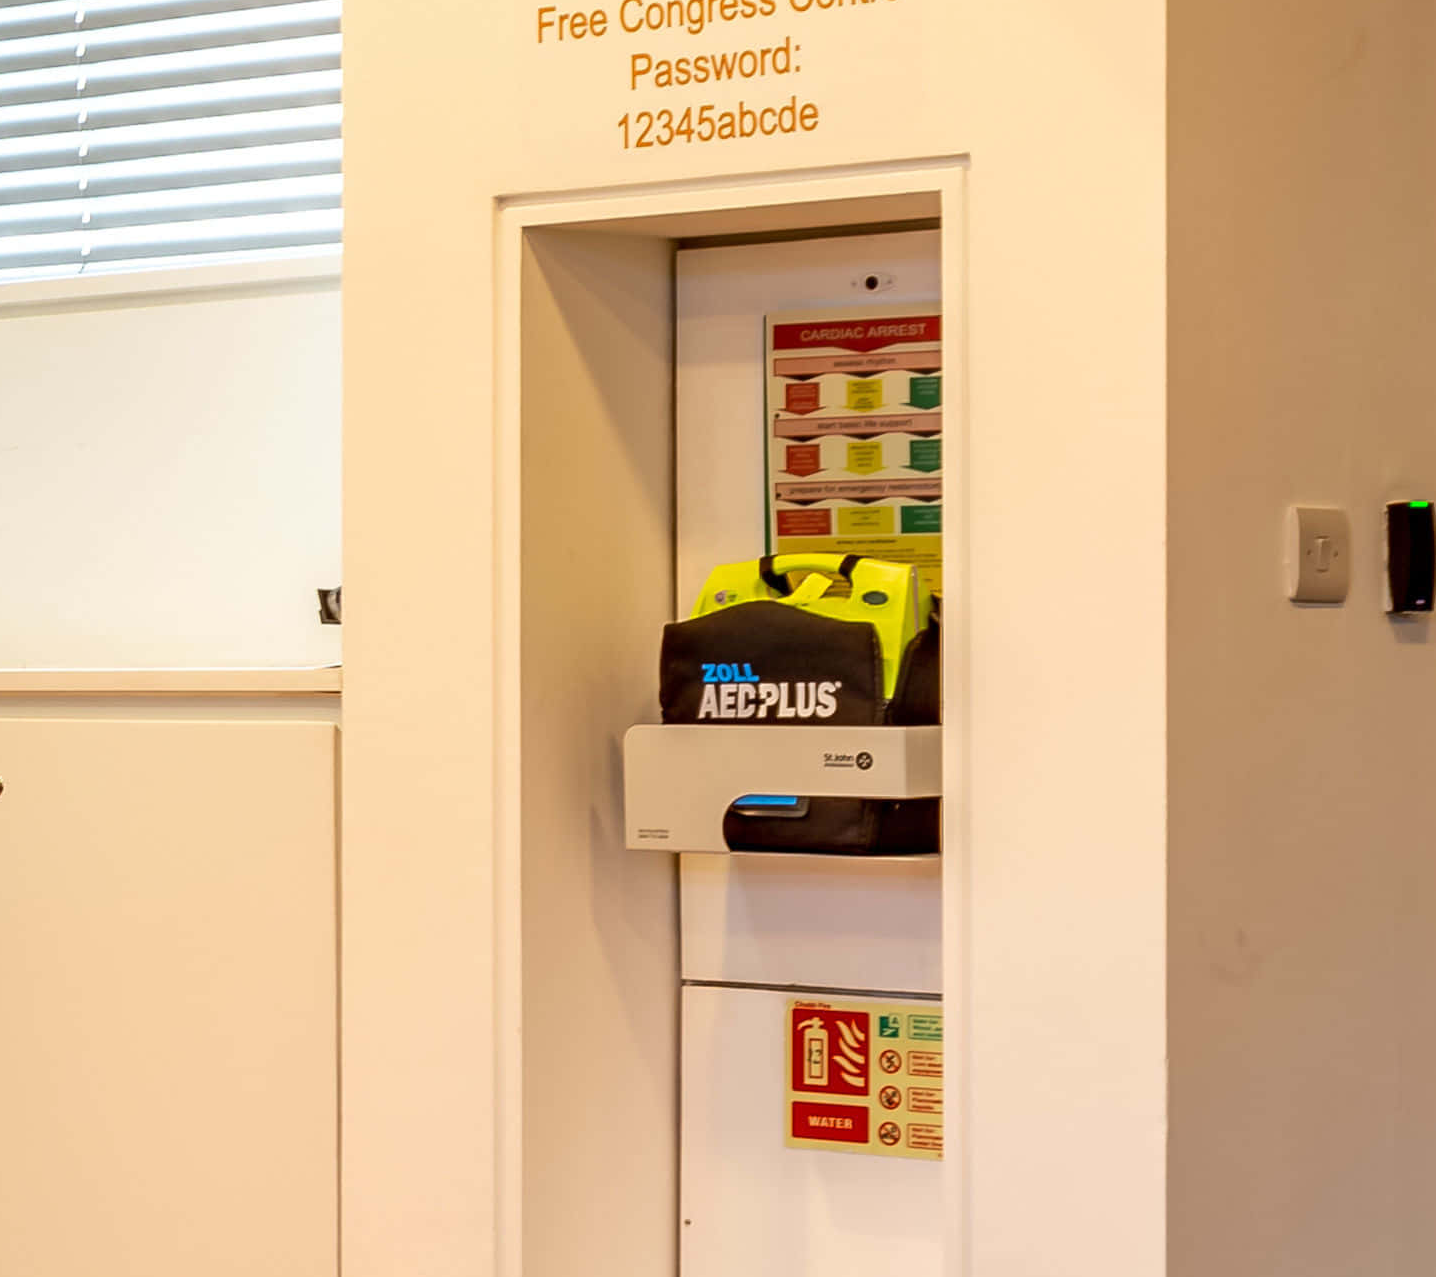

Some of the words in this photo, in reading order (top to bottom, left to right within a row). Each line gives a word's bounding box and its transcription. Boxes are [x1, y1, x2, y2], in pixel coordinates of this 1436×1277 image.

[537, 6, 608, 43] Free
[630, 35, 802, 91] Password:
[617, 95, 819, 149] 12345abcde
[800, 327, 865, 342] CARDIAC
[866, 322, 927, 339] ARREST
[701, 663, 760, 683] ZOLL
[808, 1115, 852, 1129] WATER
